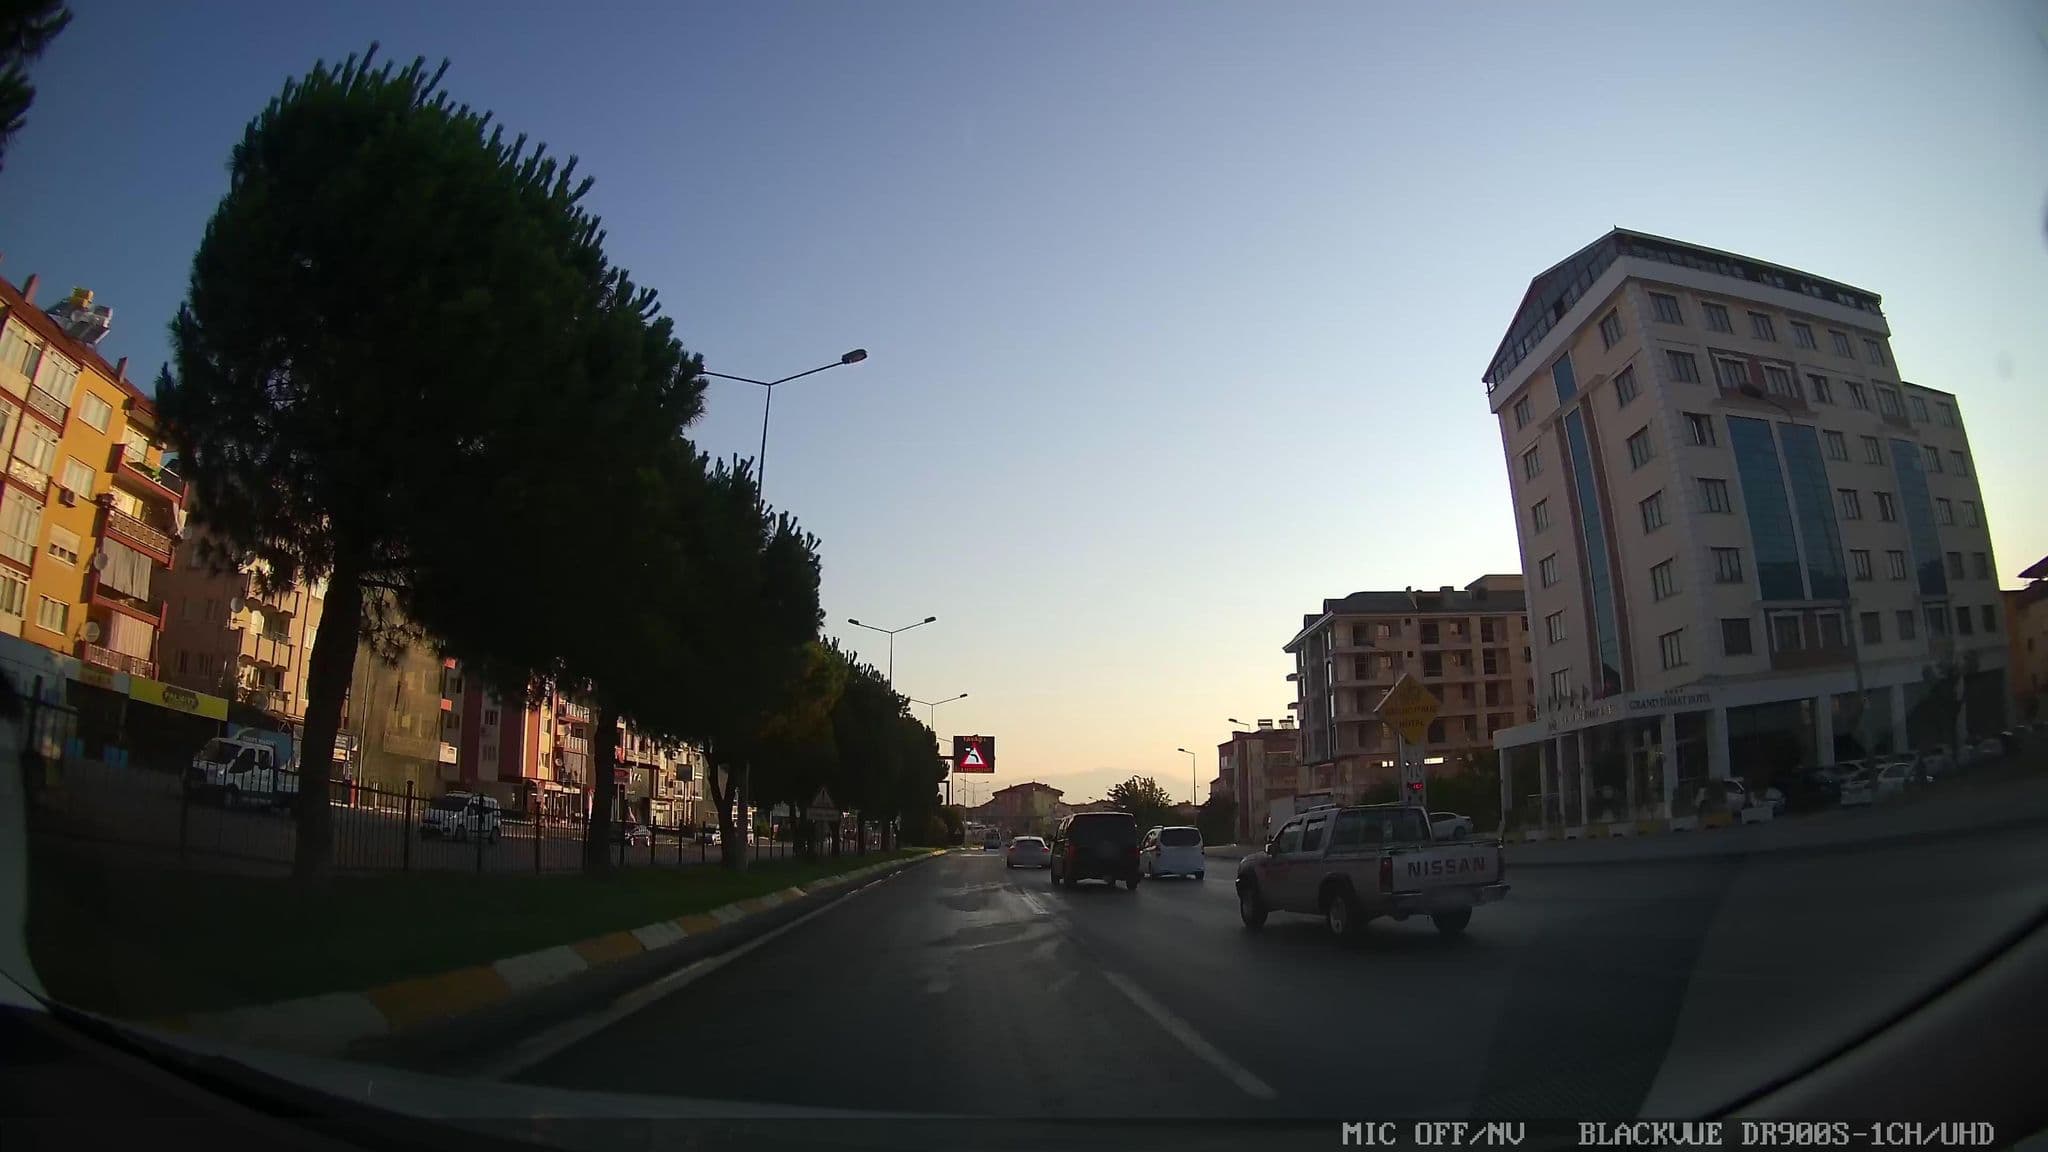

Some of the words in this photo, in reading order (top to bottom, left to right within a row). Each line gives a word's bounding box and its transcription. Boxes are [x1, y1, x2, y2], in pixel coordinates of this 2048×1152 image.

[1629, 698, 1658, 710] GRAND
[1688, 693, 1711, 705] HOTEL
[1407, 857, 1485, 878] NISSAN
